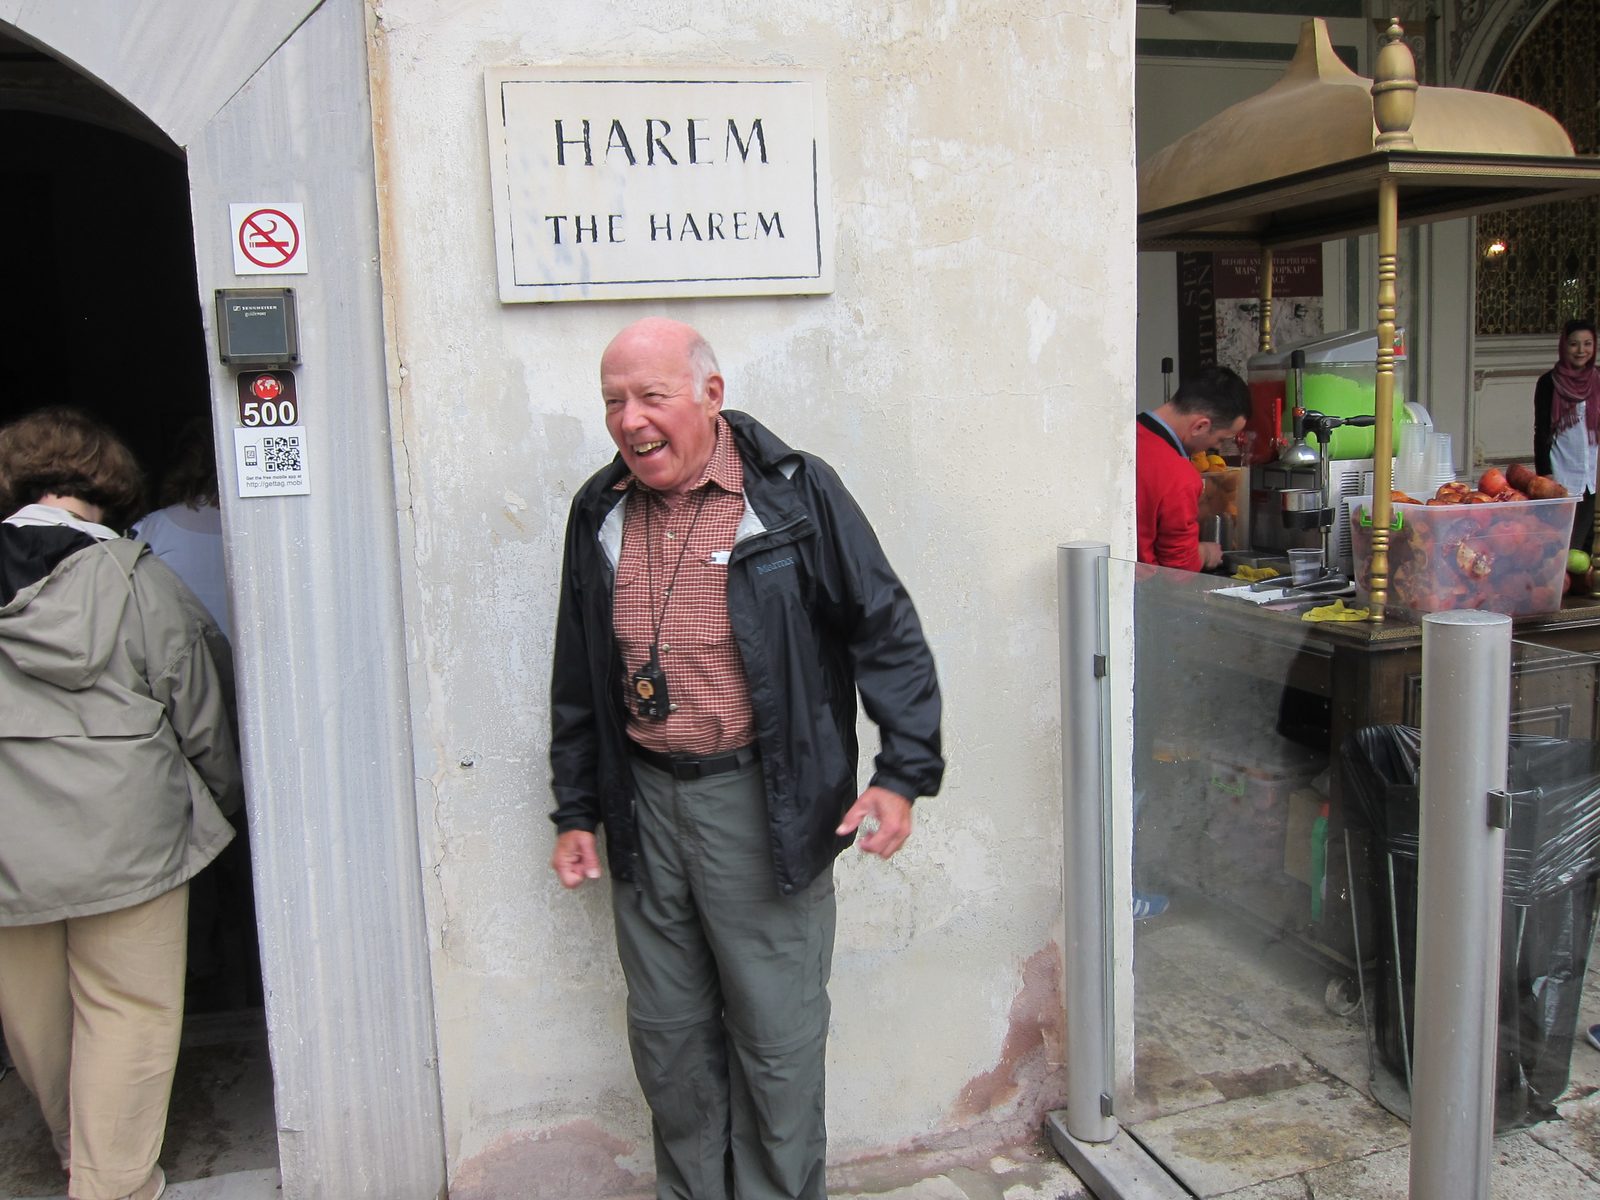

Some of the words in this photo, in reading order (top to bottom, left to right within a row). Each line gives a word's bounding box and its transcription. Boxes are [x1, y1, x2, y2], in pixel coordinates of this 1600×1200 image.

[554, 118, 769, 166] HAREM
[545, 214, 626, 245] THE
[650, 211, 785, 242] HAREM
[243, 400, 295, 427] 500
